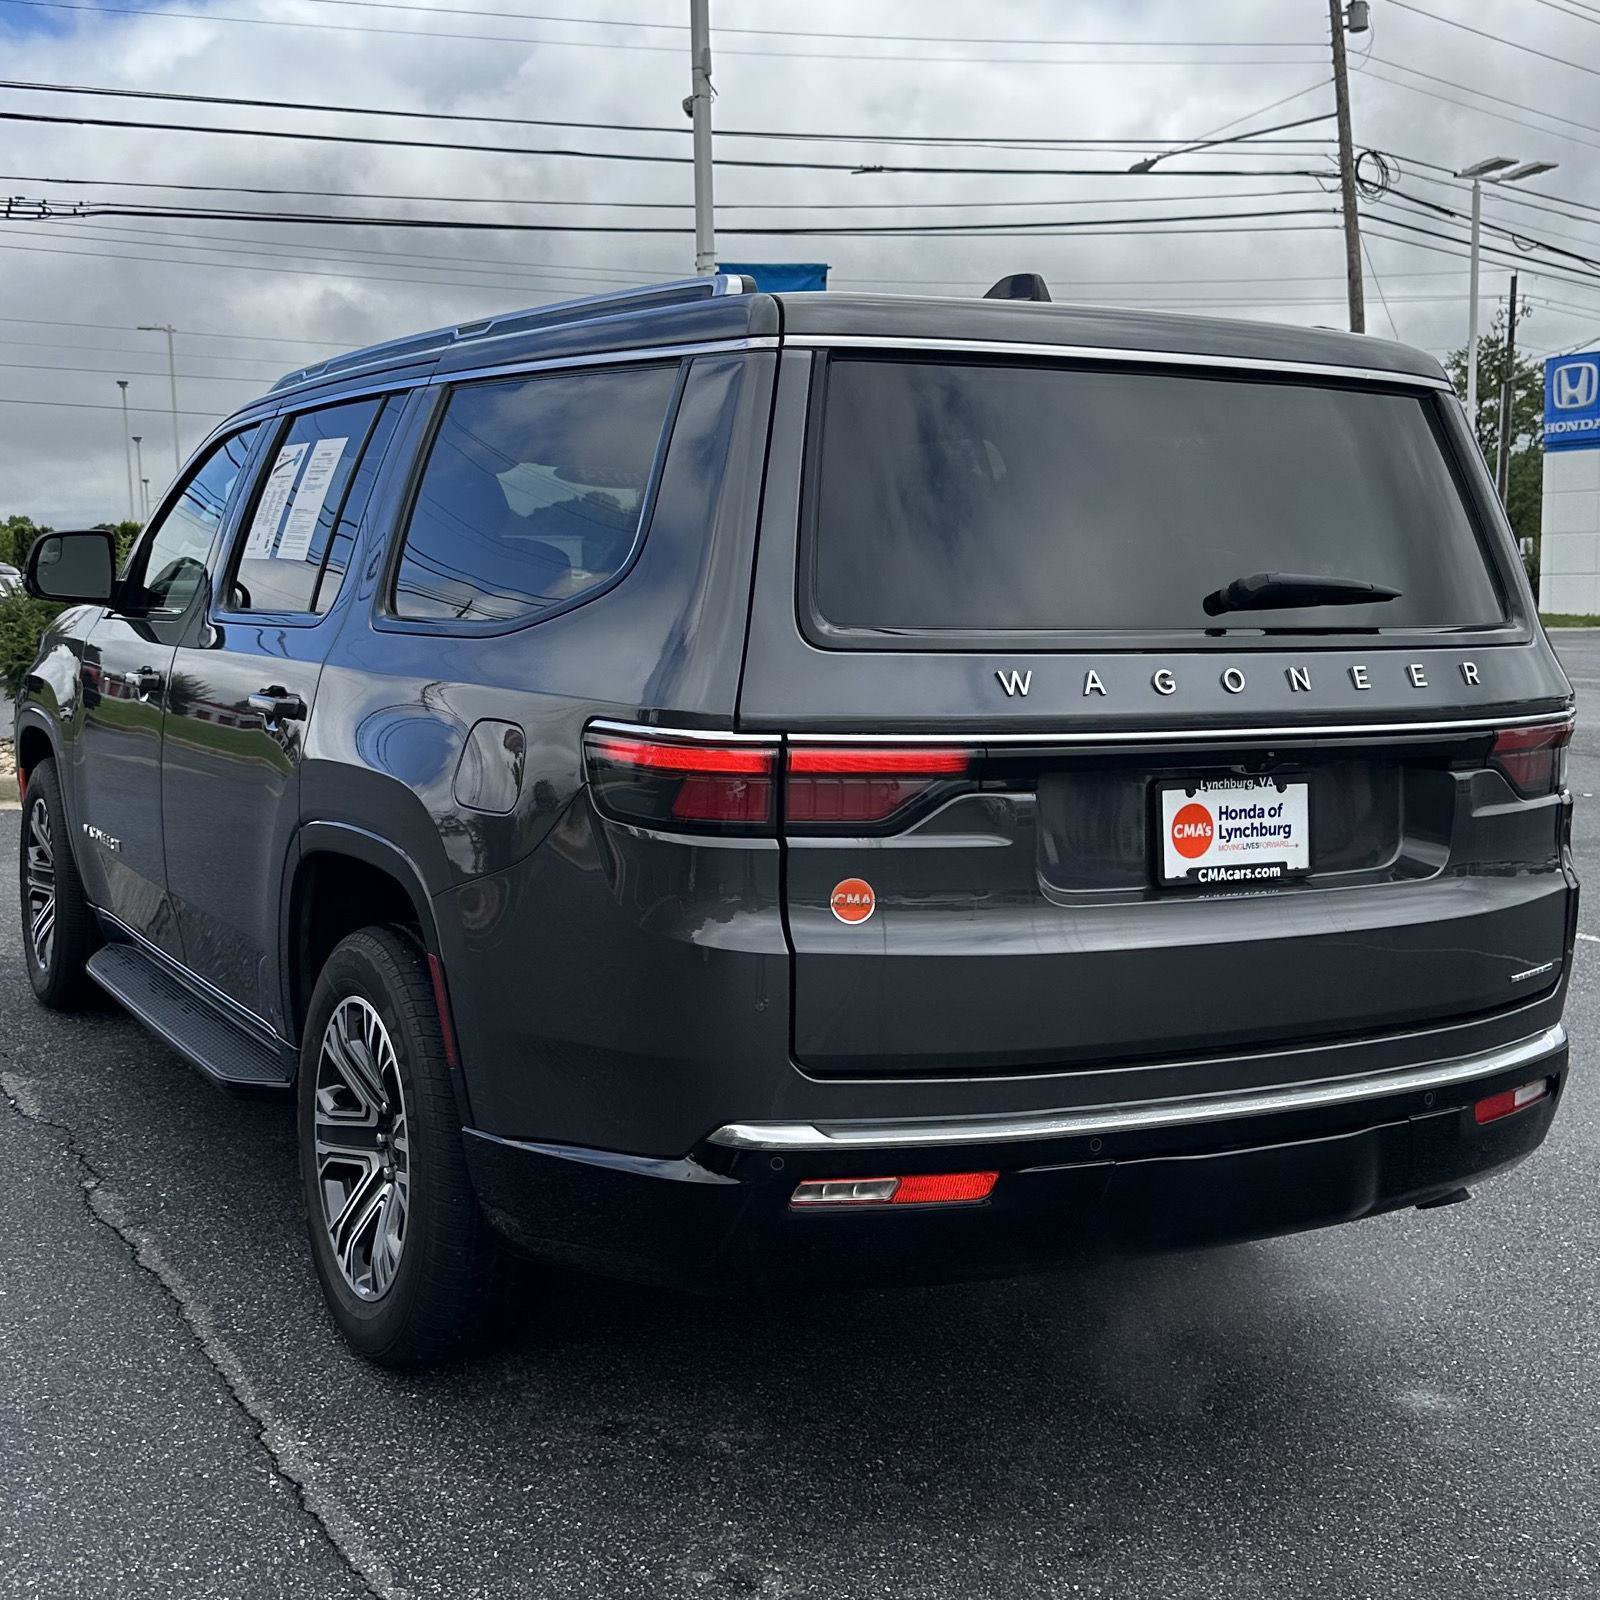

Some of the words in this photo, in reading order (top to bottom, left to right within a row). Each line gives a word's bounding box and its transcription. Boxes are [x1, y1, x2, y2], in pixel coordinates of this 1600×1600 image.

[995, 661, 1481, 696] WAGONEER
[1259, 776, 1275, 787] VA
[1218, 804, 1265, 821] Honda
[1267, 802, 1284, 818] of
[1173, 823, 1212, 838] CMA's
[1218, 822, 1292, 843] Lynchburg
[1198, 866, 1281, 882] CMAcars.com
[834, 893, 871, 905] CMA
